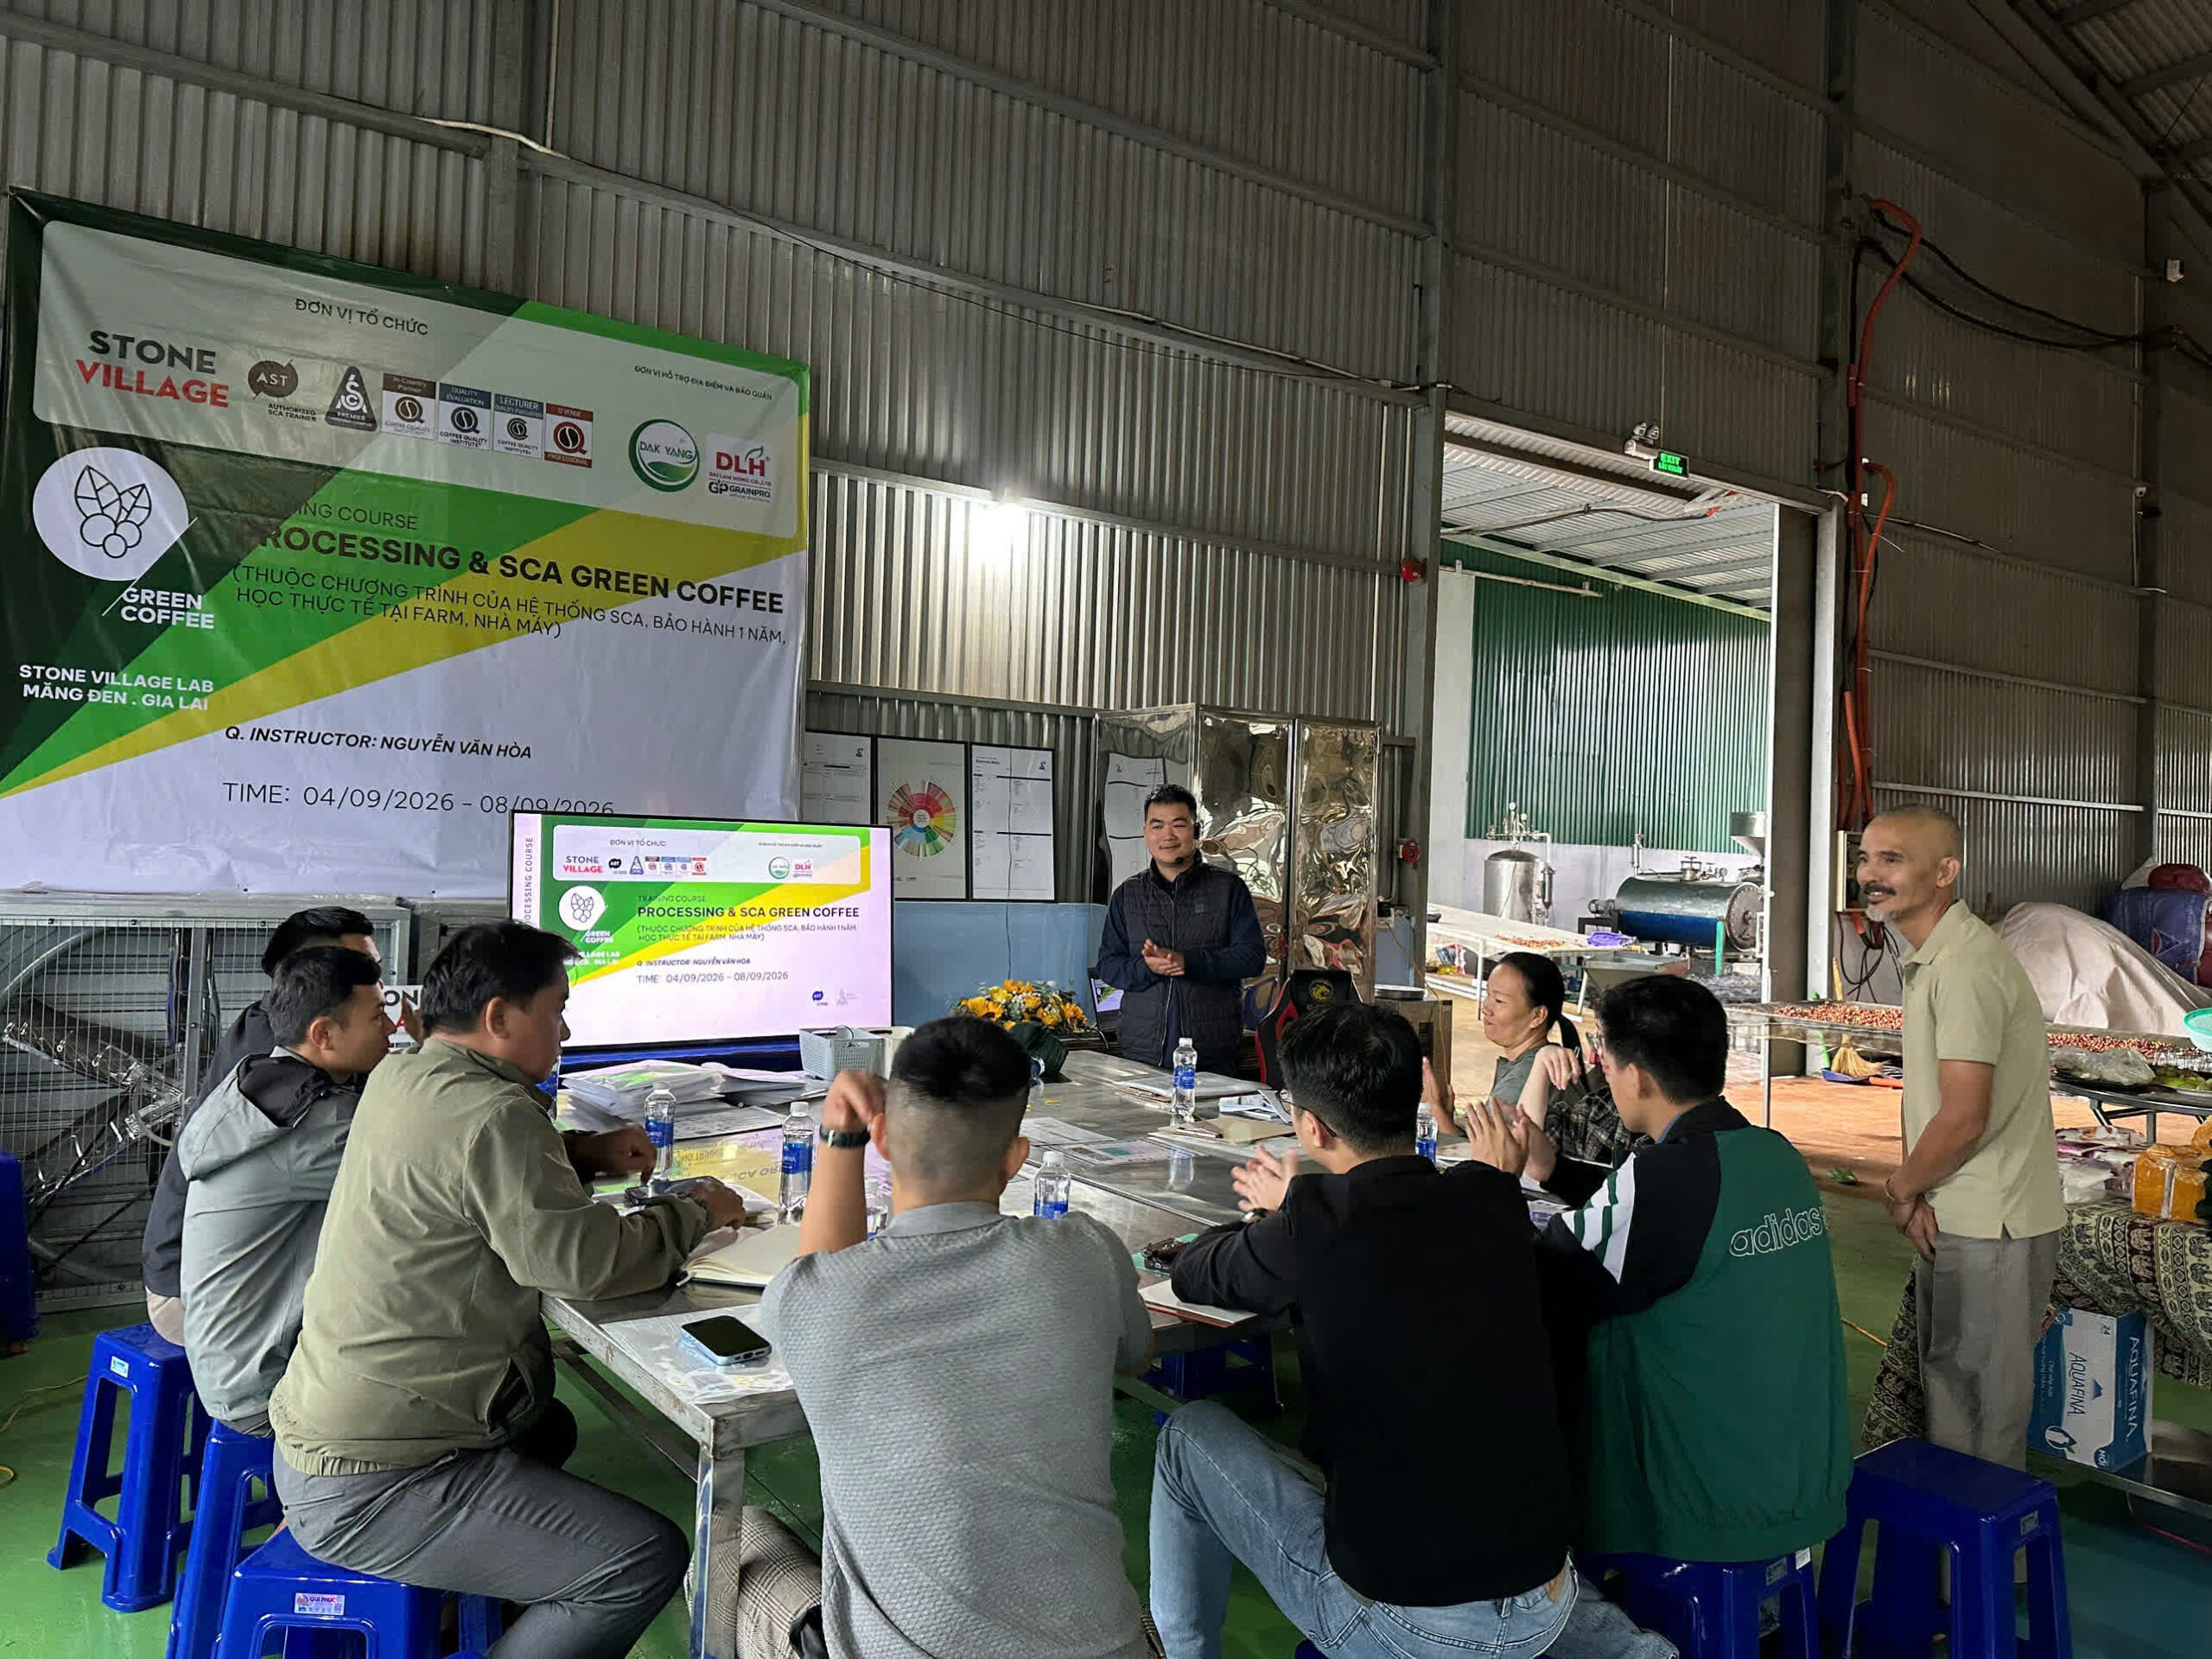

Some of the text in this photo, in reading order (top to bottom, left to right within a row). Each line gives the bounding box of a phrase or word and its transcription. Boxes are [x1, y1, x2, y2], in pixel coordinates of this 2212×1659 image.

[295, 298, 428, 335] ĐƠN VỊ TỔ CHỨC
[88, 330, 216, 374] STONE
[76, 359, 229, 408] VILLAGE
[256, 372, 288, 387] AST
[268, 403, 316, 416] AUTHORIZED
[499, 396, 538, 410] LECTURER
[268, 409, 316, 423] SCA TRAINER
[440, 431, 487, 444] COFFEE QUALITY
[639, 441, 693, 460] DAK YANG
[729, 486, 771, 498] GRAINPRO
[338, 505, 417, 530] COURSE
[468, 550, 489, 575] &
[499, 555, 563, 584] SCA
[571, 565, 669, 599] GREEN
[677, 580, 783, 613] COFFEE
[122, 588, 202, 609] GREEN
[232, 563, 315, 589] (THUỘC
[414, 583, 467, 606] TRÌNH
[473, 590, 511, 611] CỦA
[517, 597, 538, 617] HỆ
[544, 599, 605, 621] THỐNG
[610, 610, 648, 629] SCA,
[653, 613, 687, 632] BẢO
[691, 618, 734, 639] HÀNH
[739, 627, 744, 639] 1
[748, 626, 785, 645] NĂM,
[120, 606, 214, 629] COFFEE
[237, 588, 561, 639] HỌC THỰC TẾ TẠI FARM, NHÀ MÁY)
[19, 664, 213, 692] STONE VILLAGE LAB
[22, 683, 84, 702] MĂNG
[87, 689, 127, 704] ĐEN
[142, 694, 174, 709] GIA
[179, 698, 208, 710] LAI
[225, 726, 532, 759] Q. INSTRUCTOR: NGUYỄN VĂN HÒA
[223, 782, 290, 804] TIME:
[303, 786, 454, 811] 04/09/2026
[562, 865, 604, 874] VILLAGE
[565, 855, 600, 864] STONE
[638, 907, 860, 918] PROCESSING & SCA GREEN COFFEE
[666, 972, 724, 983] 04/09/2026
[734, 971, 788, 982] 08/09/2026
[1730, 1206, 1825, 1257] adidas
[2103, 1325, 2110, 1335] 24
[2069, 1351, 2088, 1416] AQUAFINA
[2128, 1337, 2139, 1438] AQUAFINA
